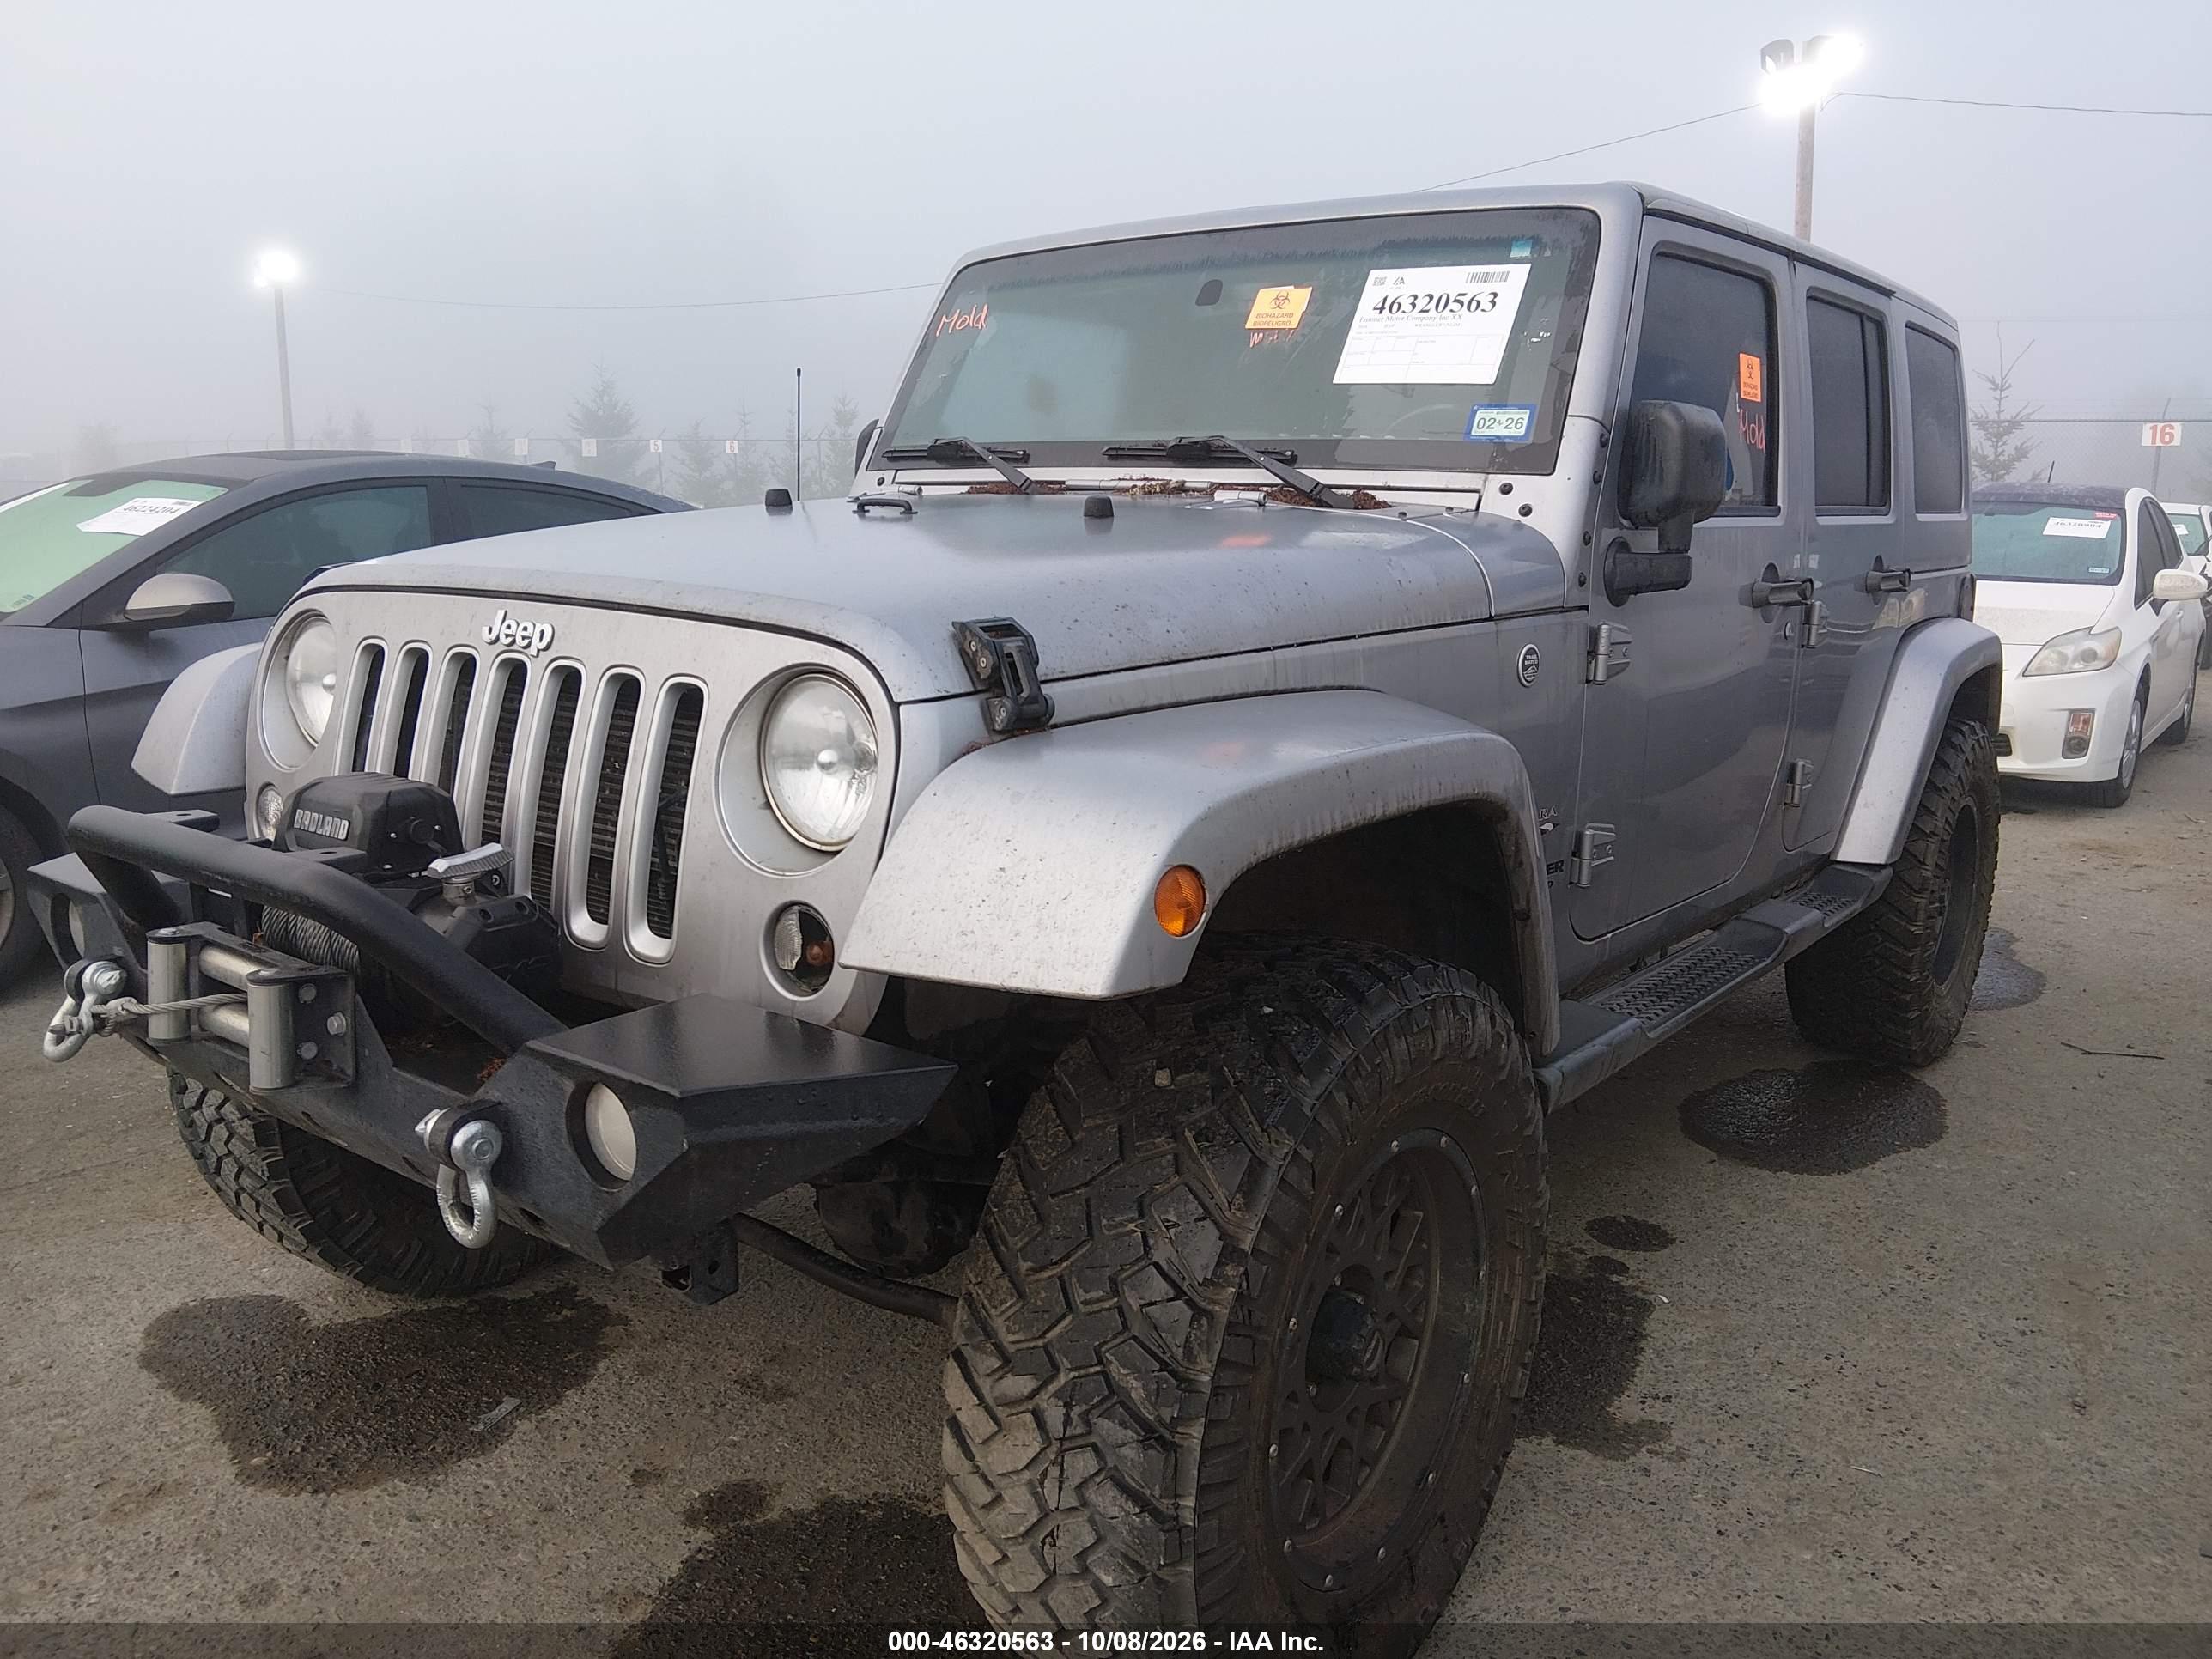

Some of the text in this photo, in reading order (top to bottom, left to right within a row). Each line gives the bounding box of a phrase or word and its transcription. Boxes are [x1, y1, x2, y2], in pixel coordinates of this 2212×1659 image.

[1372, 291, 1498, 315] 46320563
[935, 303, 988, 337] Mold
[1476, 416, 1525, 430] 02 26
[653, 441, 659, 452] 5
[2149, 424, 2175, 446] 16
[730, 441, 735, 453] 6
[482, 610, 555, 658] Jeep
[293, 809, 350, 841] BADLAND
